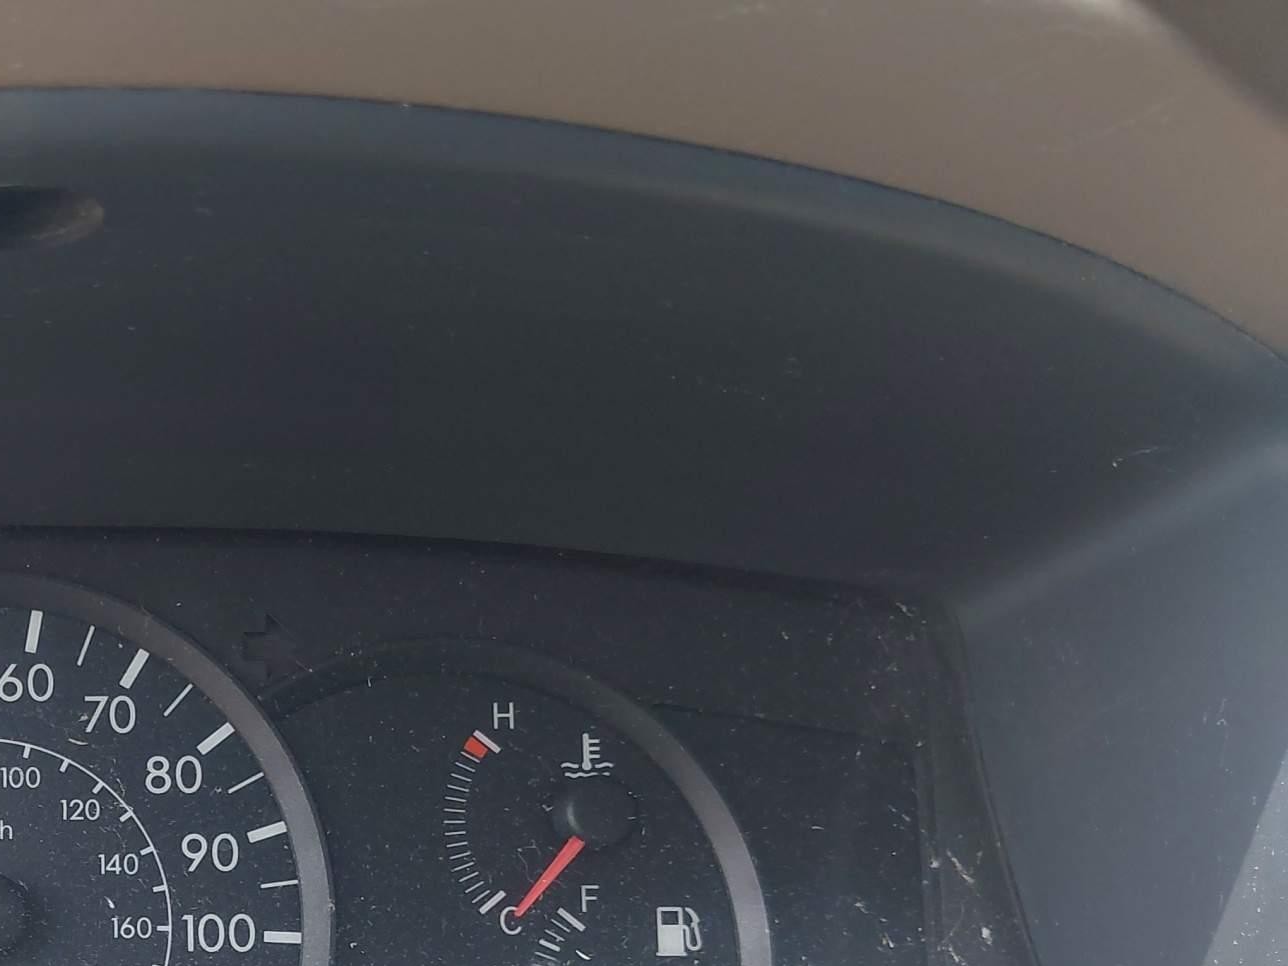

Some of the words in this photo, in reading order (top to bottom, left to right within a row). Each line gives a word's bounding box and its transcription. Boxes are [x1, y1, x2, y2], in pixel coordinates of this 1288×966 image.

[83, 695, 137, 733] 70
[492, 702, 515, 729] H
[0, 767, 41, 789] 100
[145, 755, 202, 794] 80
[60, 799, 101, 821] 120
[97, 853, 139, 876] 140
[181, 832, 240, 873] 90
[580, 885, 600, 913] F
[110, 917, 153, 940] 160
[182, 913, 256, 953] 100
[499, 906, 523, 936] C
